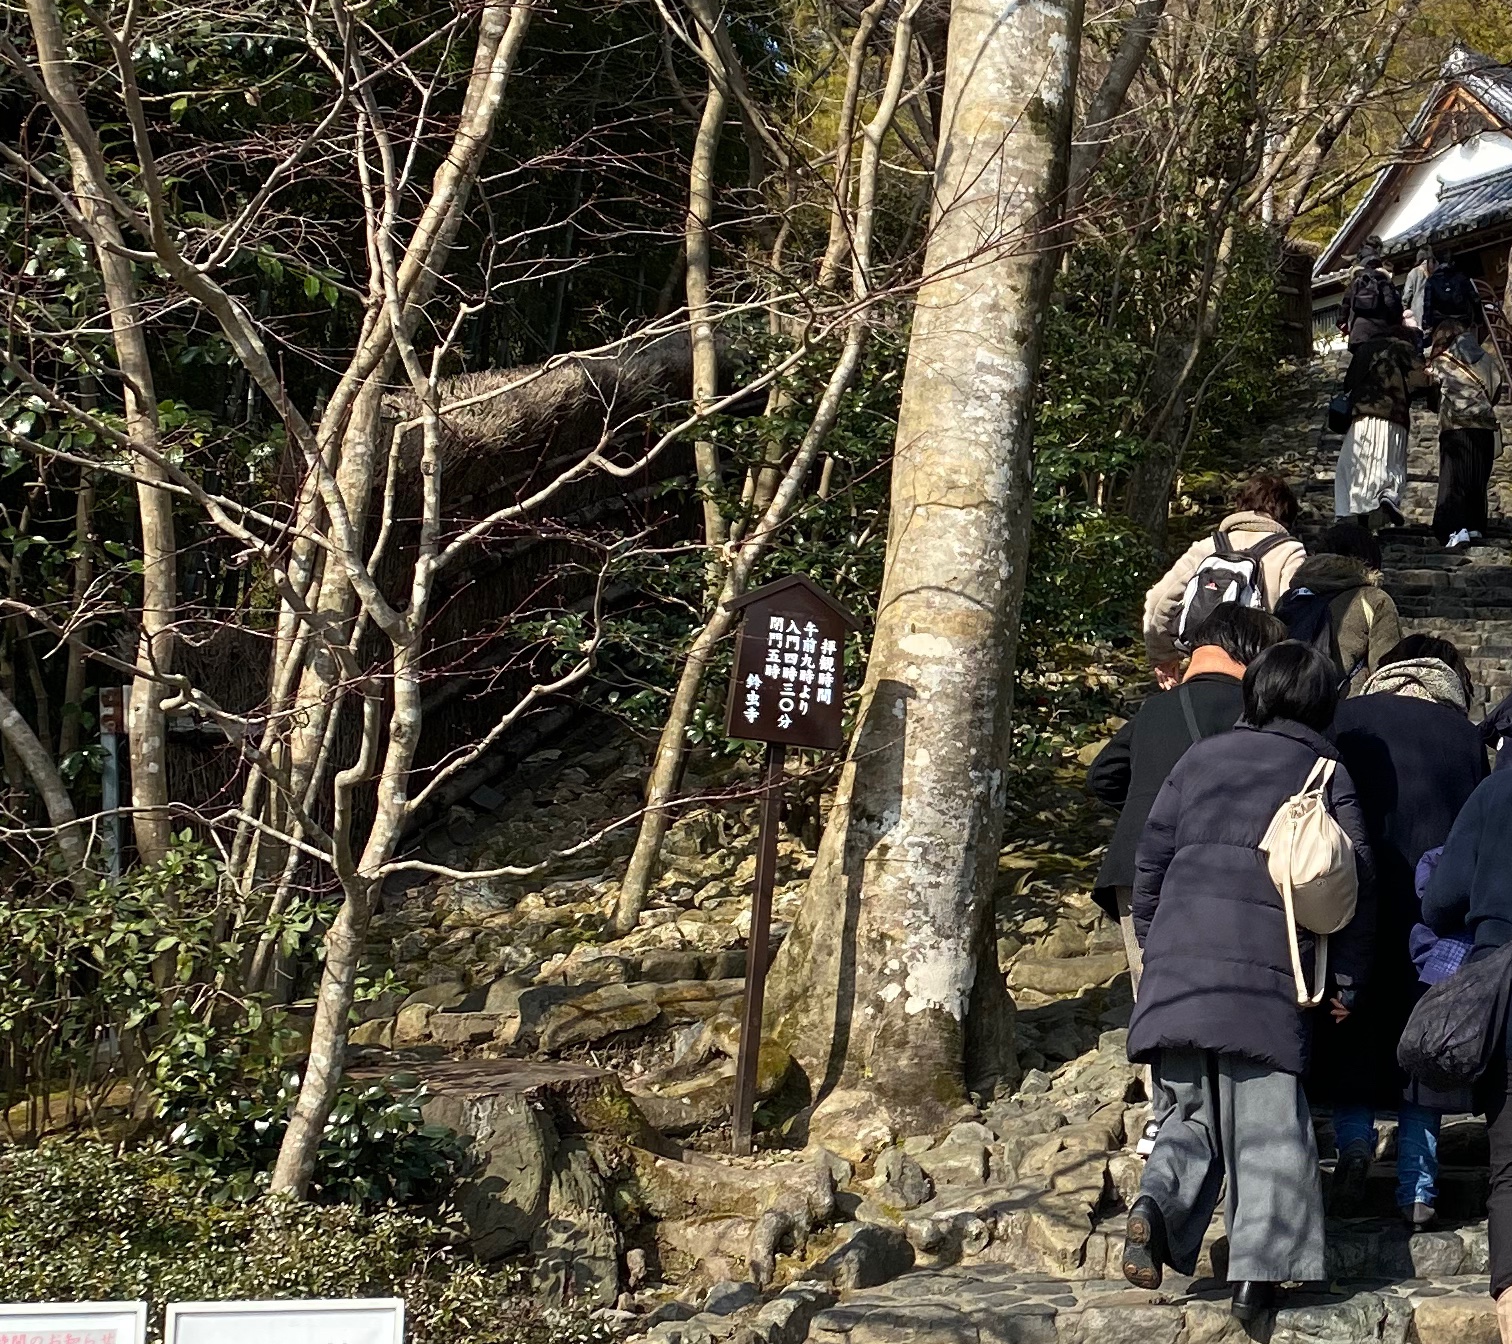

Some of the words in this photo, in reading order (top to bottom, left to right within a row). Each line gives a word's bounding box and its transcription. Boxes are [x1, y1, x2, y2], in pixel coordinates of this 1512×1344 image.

[764, 616, 785, 680] 閉門五時
[799, 621, 819, 716] 午前九時より
[817, 638, 838, 705] 拝観時間
[743, 673, 763, 724] 鈴虫寺
